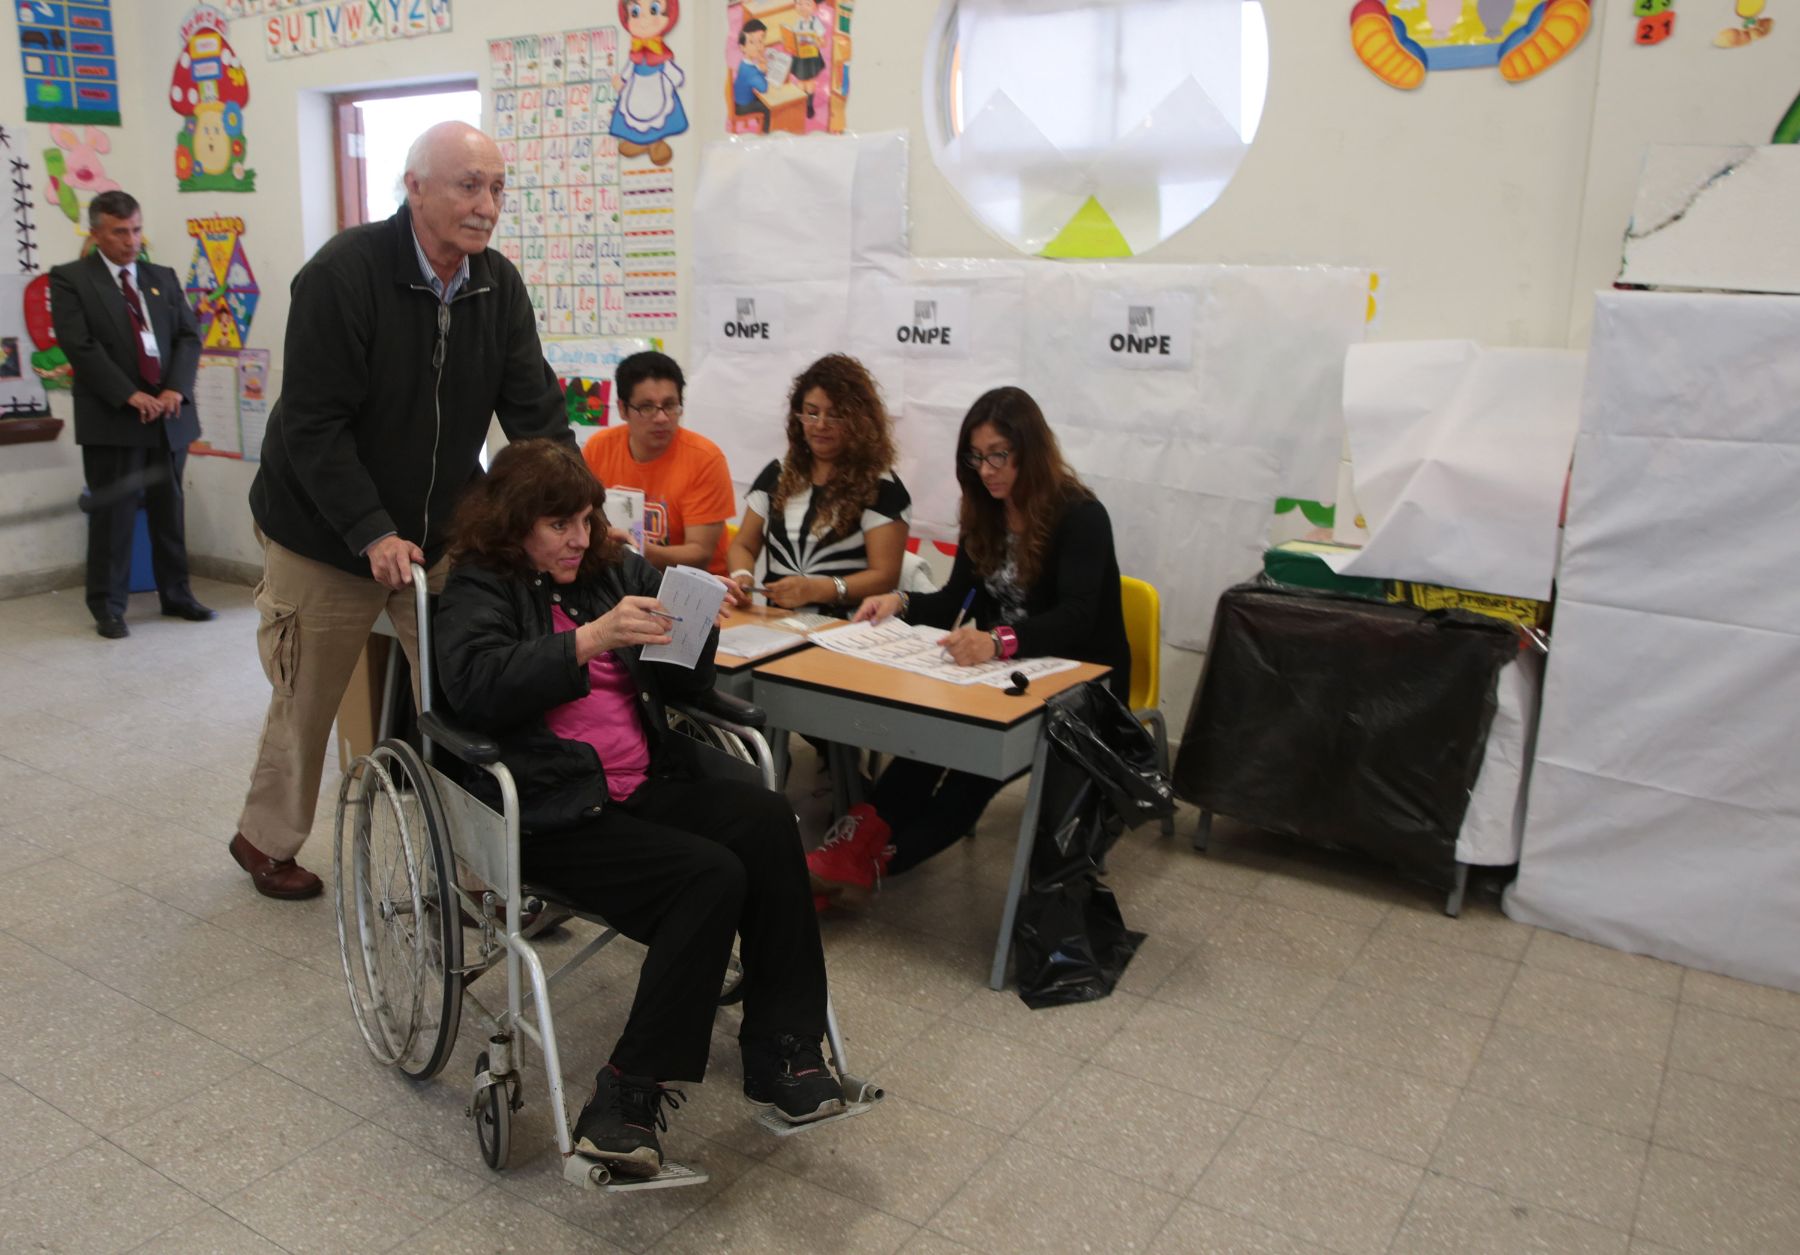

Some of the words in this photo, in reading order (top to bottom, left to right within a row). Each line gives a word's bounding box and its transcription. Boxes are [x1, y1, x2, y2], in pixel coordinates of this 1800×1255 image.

[724, 321, 770, 340] ONPE
[896, 325, 952, 345] ONPE
[1109, 333, 1171, 355] ONPE
